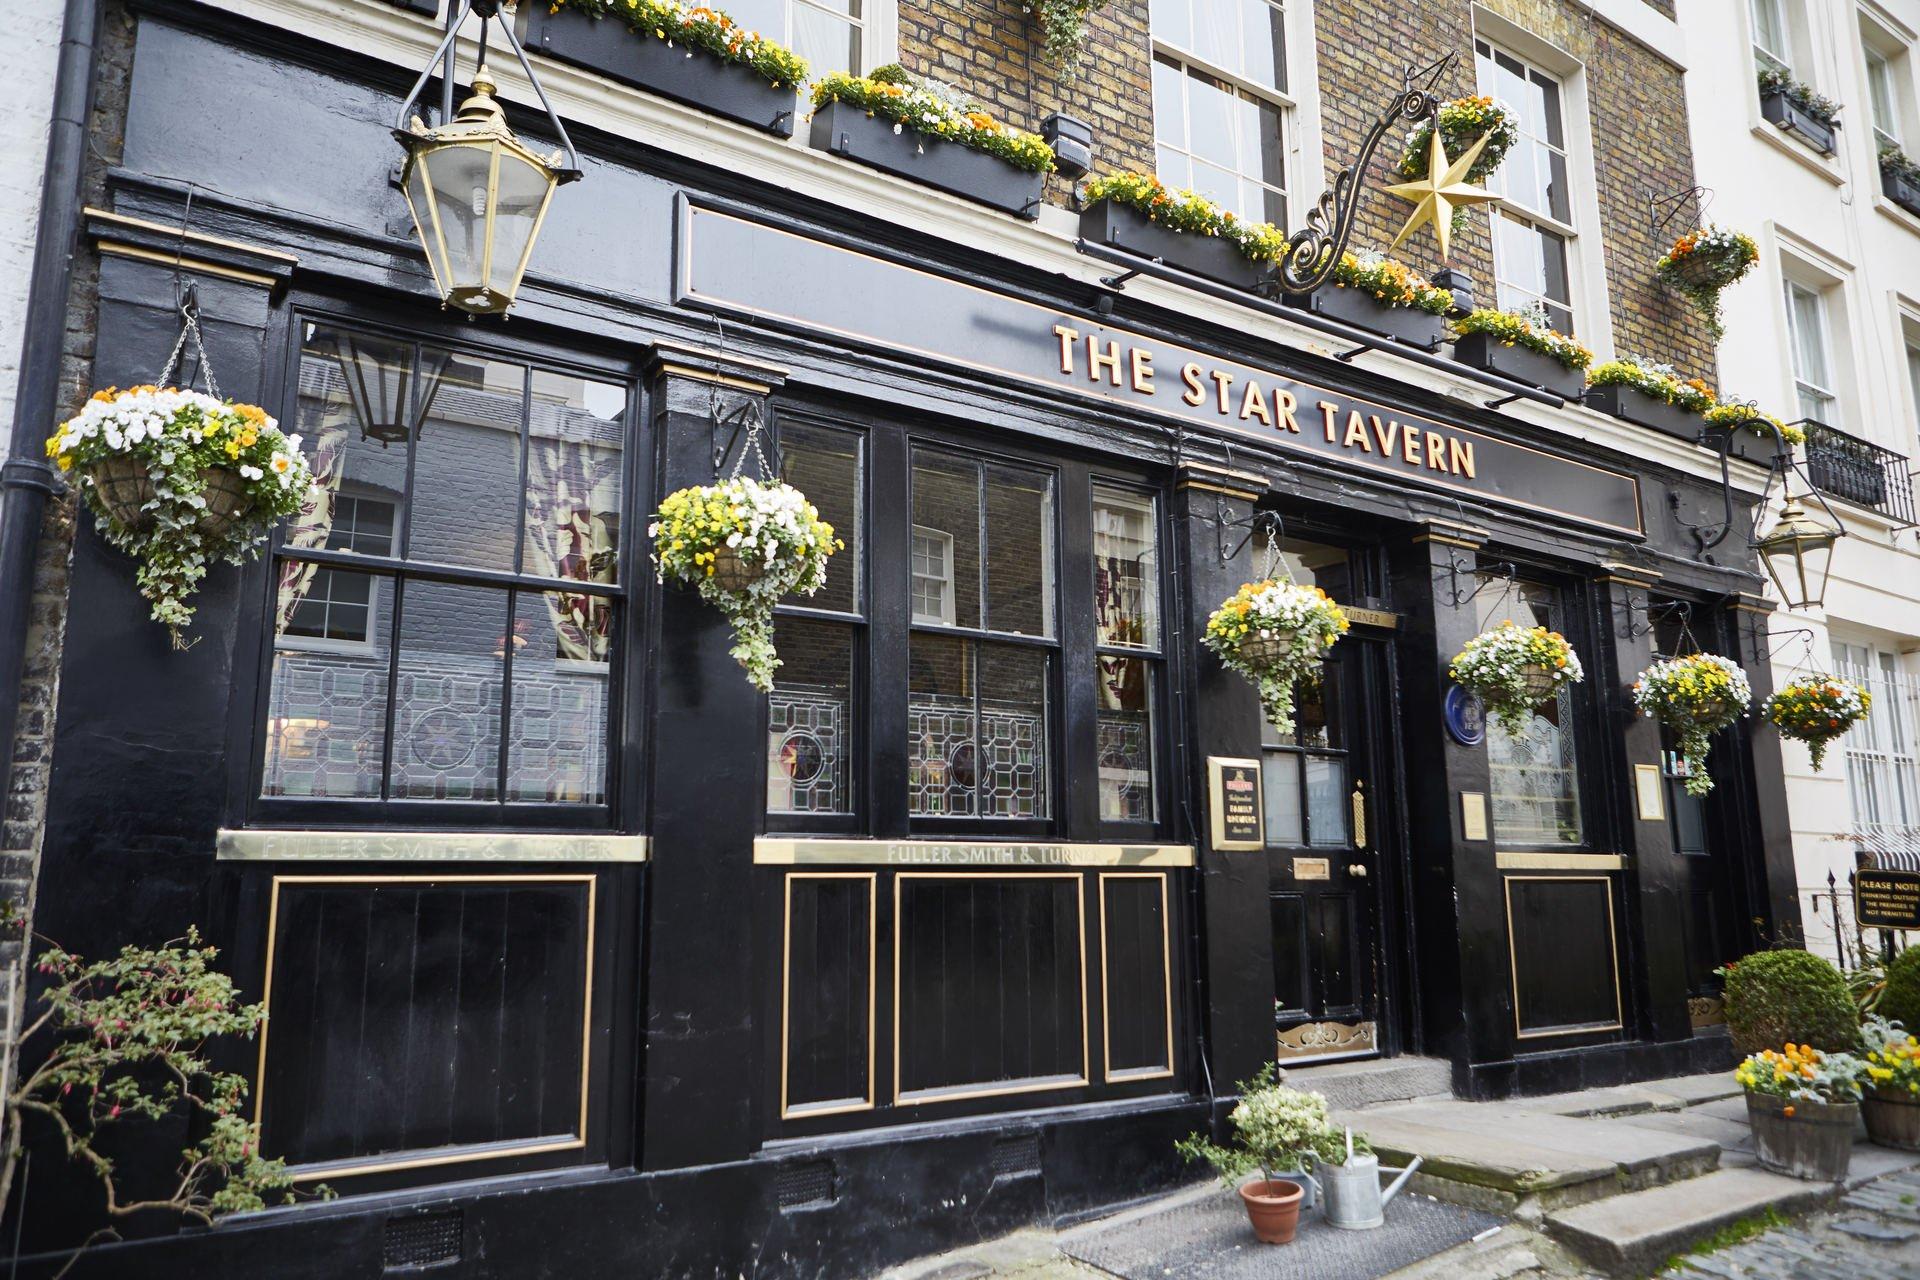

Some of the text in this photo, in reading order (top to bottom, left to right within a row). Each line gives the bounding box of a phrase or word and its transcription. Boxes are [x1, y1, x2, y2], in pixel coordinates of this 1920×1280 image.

[1052, 324, 1476, 479] THE STAR TAVERN
[1344, 607, 1380, 624] TURNER
[262, 834, 615, 861] FULLER SMITH & TURNER
[887, 844, 1101, 865] FULLER SMITH & TURN
[1860, 880, 1920, 891] PLEASE NOTE
